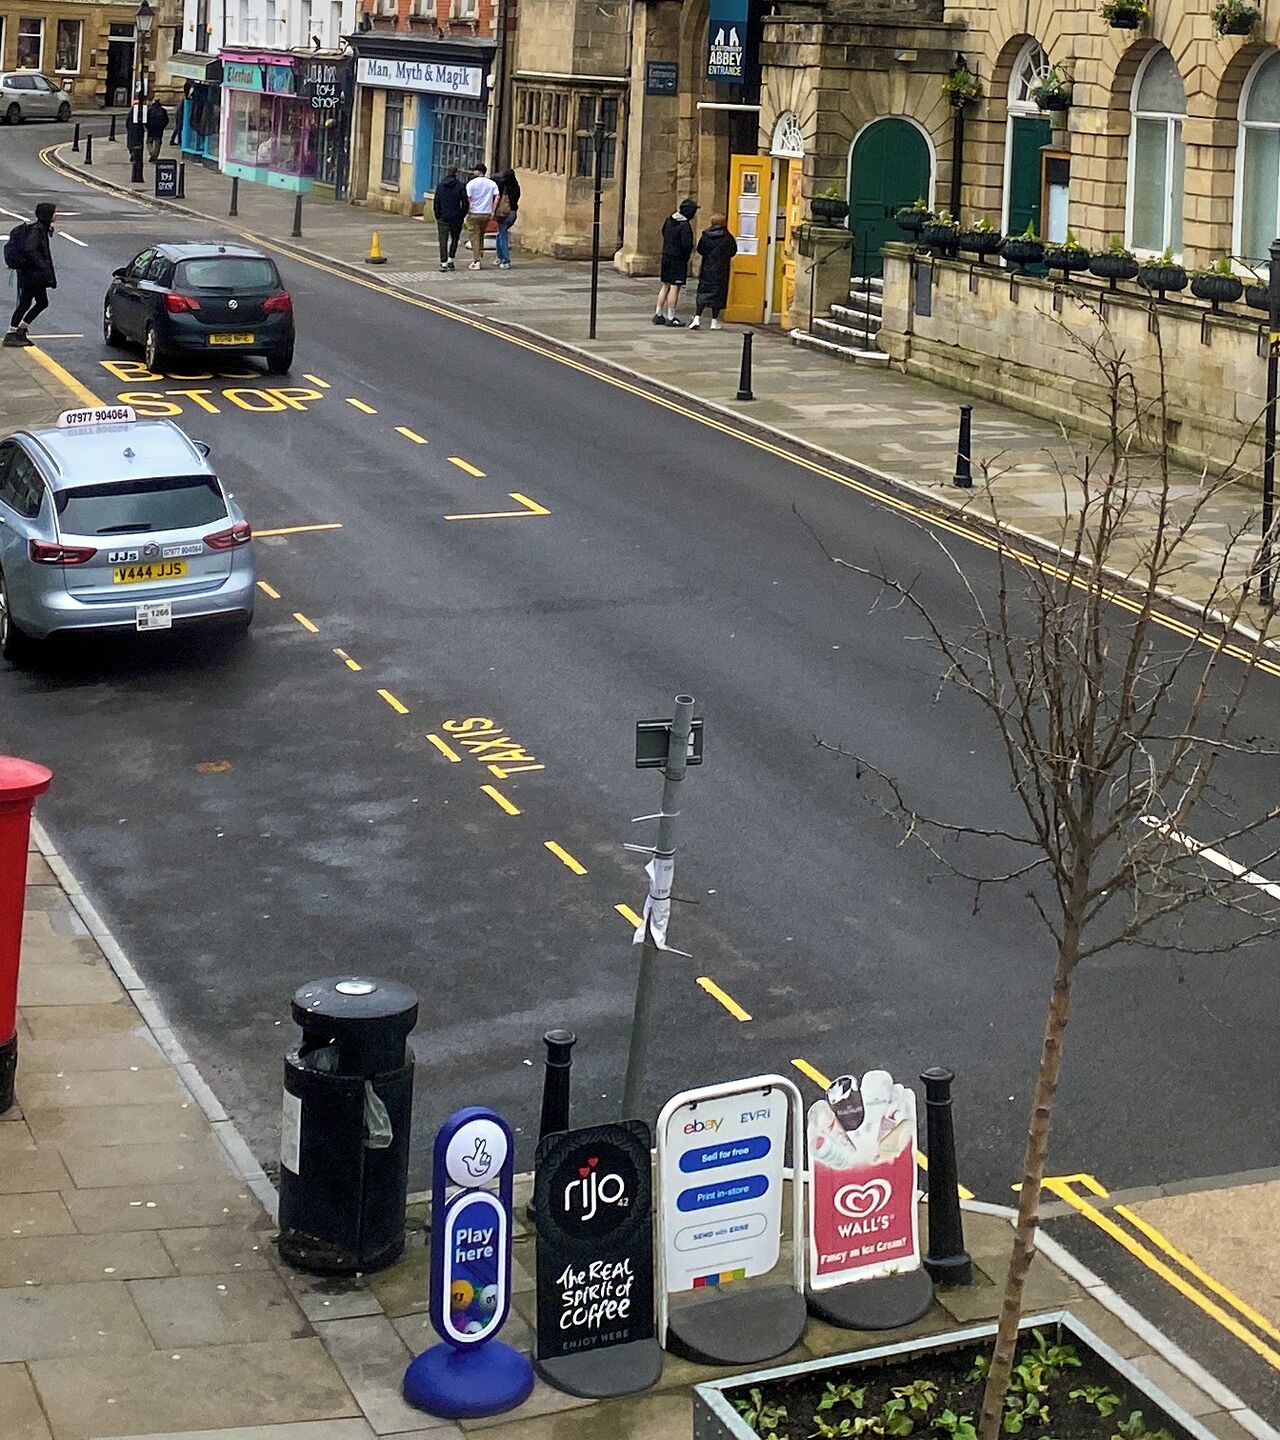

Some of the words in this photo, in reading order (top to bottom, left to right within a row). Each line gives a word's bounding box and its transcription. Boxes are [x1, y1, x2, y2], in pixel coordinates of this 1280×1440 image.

[709, 51, 742, 66] ABBEY
[367, 60, 392, 79] Man,
[396, 62, 422, 85] Myth
[424, 65, 433, 82] &
[435, 66, 469, 90] Magik
[708, 65, 742, 76] ENTRANCE
[117, 388, 324, 416] STOP
[66, 412, 92, 424] 07977
[95, 409, 128, 421] 904064
[110, 552, 137, 561] JJs
[119, 566, 152, 580] V444
[157, 563, 181, 576] JJS
[442, 717, 546, 778] TAXIS
[684, 1117, 723, 1135] ebay
[701, 1153, 718, 1163] Sell
[719, 1150, 731, 1160] for
[732, 1147, 750, 1157] free
[564, 1171, 625, 1221] rijo
[696, 1191, 715, 1202] Print
[716, 1185, 749, 1199] in-store
[455, 1226, 494, 1246] Play
[693, 1231, 714, 1241] SEND
[729, 1224, 750, 1233] EASE
[837, 1216, 890, 1239] WALL'S
[455, 1245, 494, 1263] here
[820, 1250, 847, 1265] Fancy
[849, 1248, 860, 1258] an
[861, 1244, 875, 1255] Ice
[876, 1237, 908, 1253] Cream?
[556, 1263, 587, 1290] The
[588, 1258, 634, 1282] REAL
[615, 1275, 635, 1298] of
[562, 1335, 597, 1350] ENJOY
[600, 1329, 629, 1342] HERE
